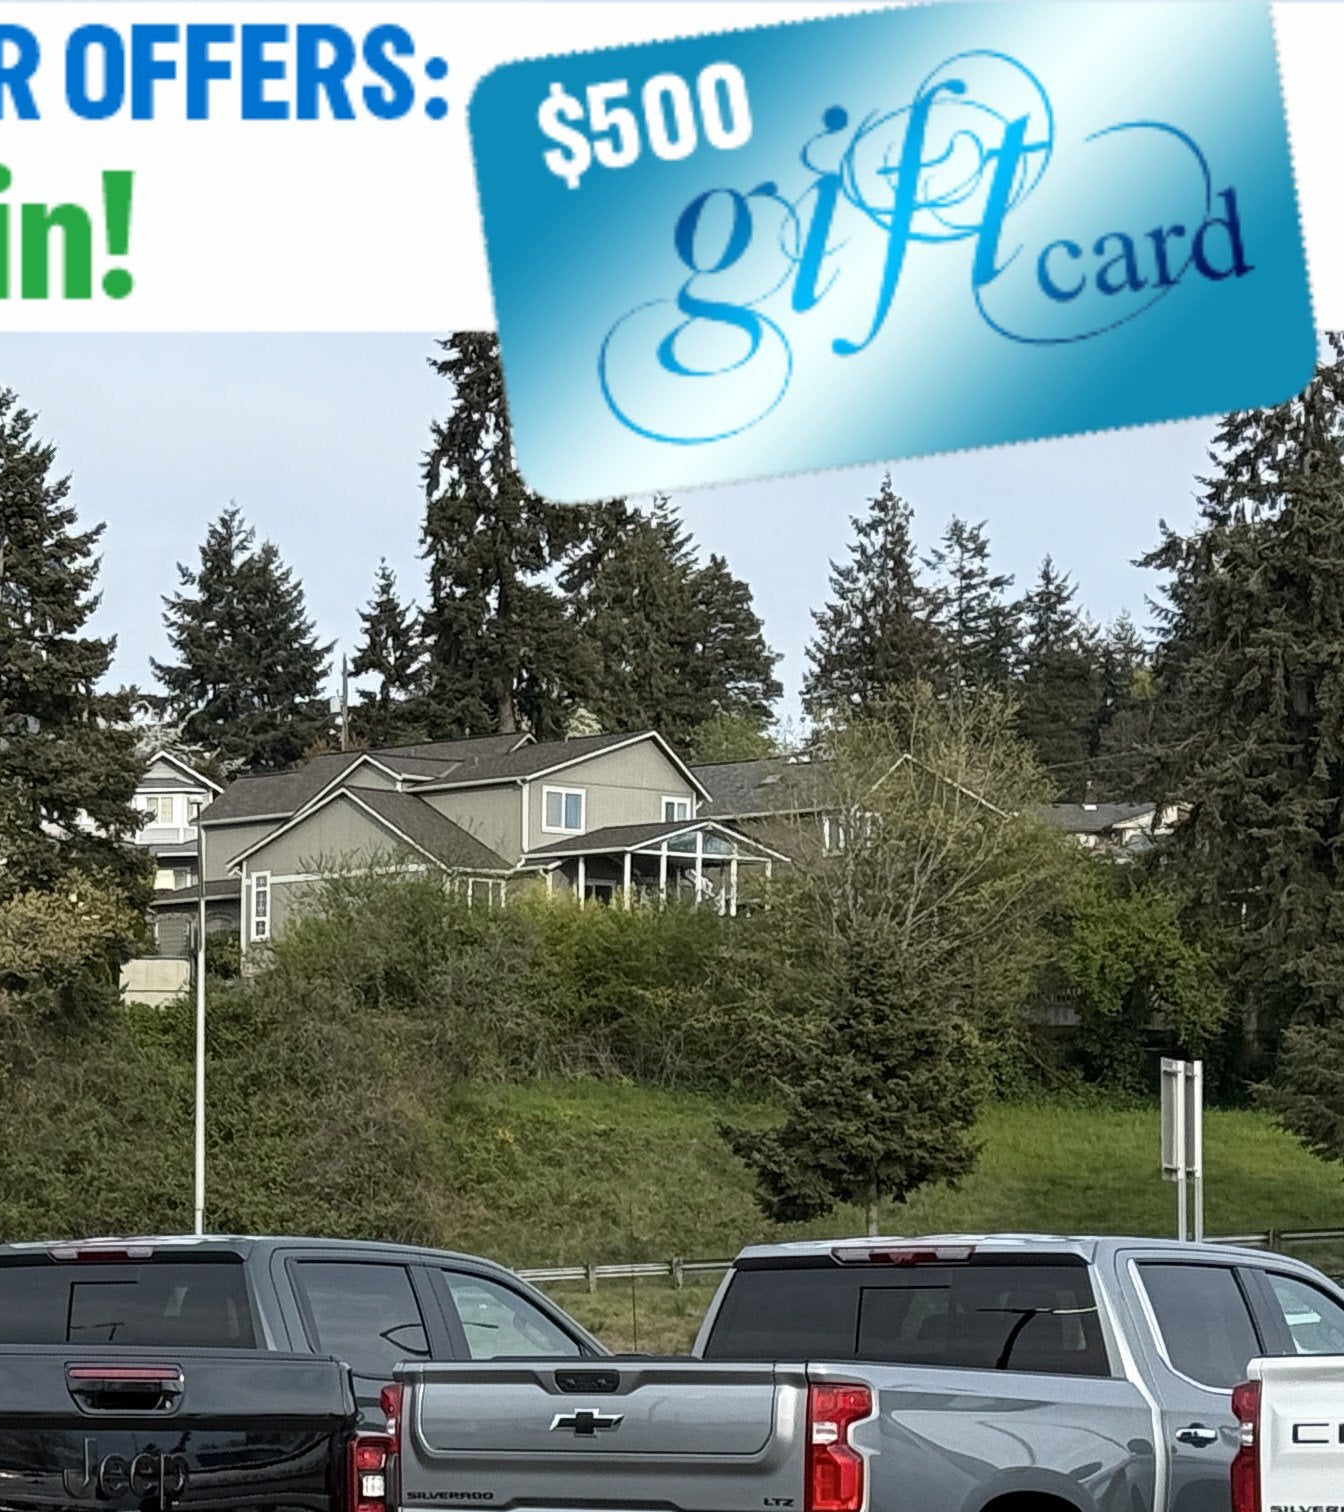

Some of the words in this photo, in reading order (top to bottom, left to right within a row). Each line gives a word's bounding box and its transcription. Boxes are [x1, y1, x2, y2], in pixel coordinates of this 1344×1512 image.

[64, 1437, 189, 1511] Jeep
[407, 1491, 494, 1500] SILVERADO
[763, 1497, 794, 1507] LTZ
